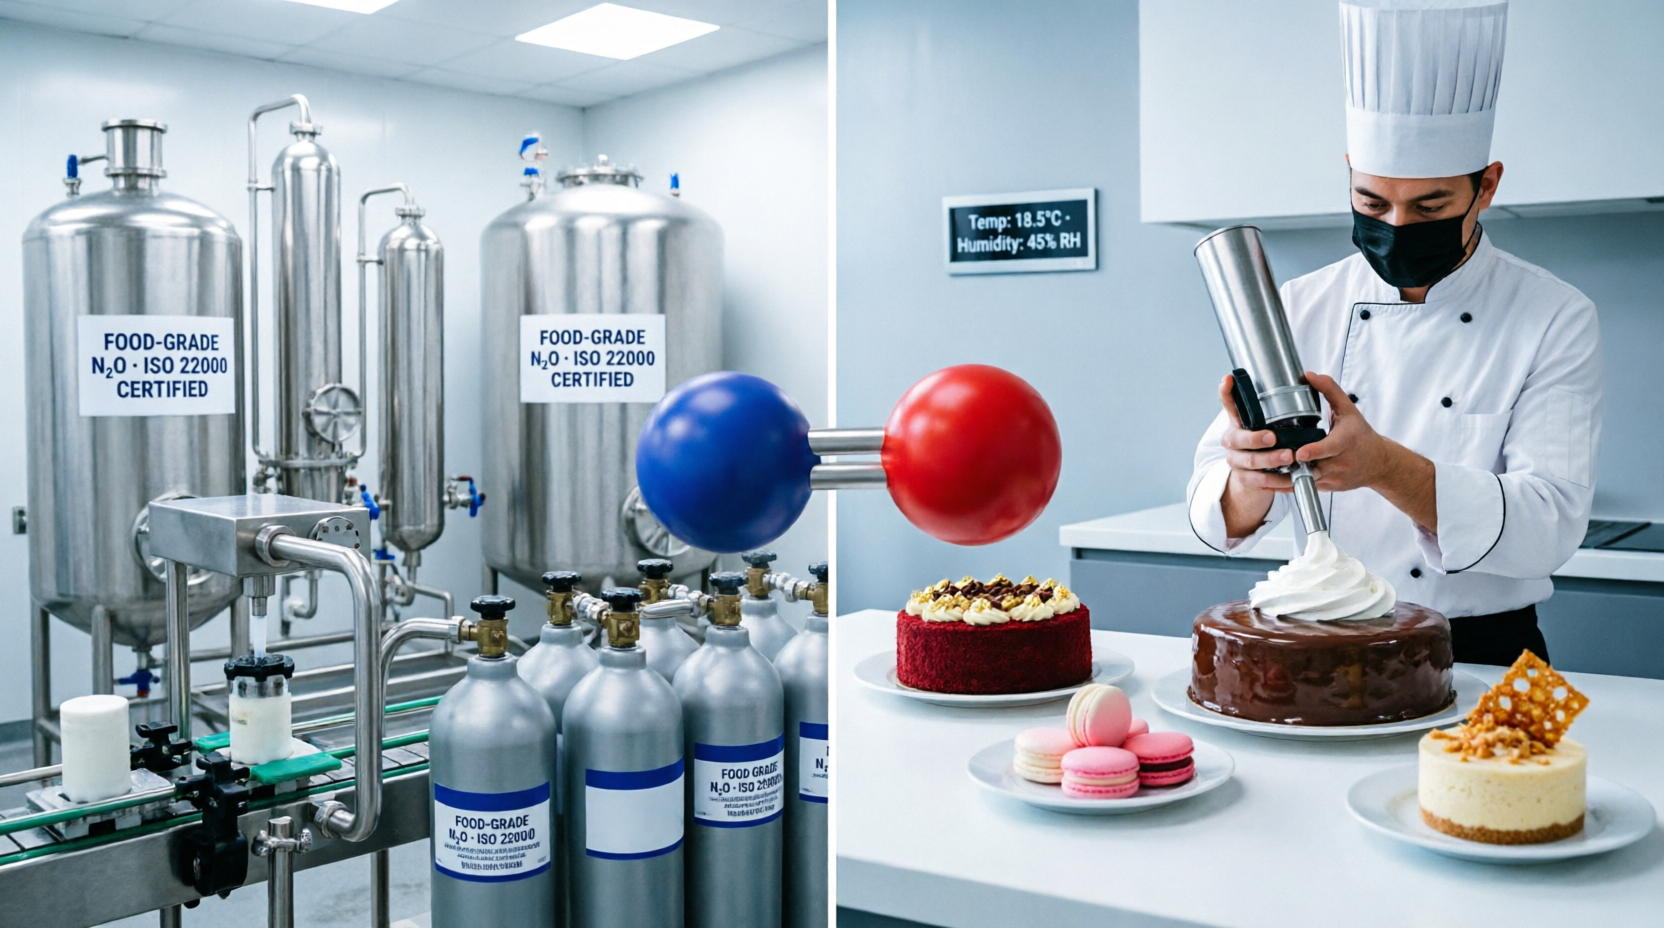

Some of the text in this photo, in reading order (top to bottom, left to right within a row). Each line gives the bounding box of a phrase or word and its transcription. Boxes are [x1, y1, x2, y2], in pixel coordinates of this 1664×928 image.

[968, 214, 1012, 233] Temp:
[1015, 210, 1062, 228] 18.5°C
[957, 231, 1081, 255] Humidity: 45% RH
[104, 333, 219, 351] FOOD-GRADE
[540, 329, 646, 345] FOOD-GRADE
[144, 356, 174, 374] ISO
[180, 356, 228, 374] 22000
[574, 350, 601, 366] ISO
[606, 350, 655, 366] 22000
[551, 371, 634, 387] CERTIFIED
[116, 380, 208, 398] CERTIFIED
[721, 768, 750, 780] FOOD
[738, 782, 755, 793] ISO
[455, 814, 529, 830] FOOD-GRADE
[477, 833, 497, 845] ISO
